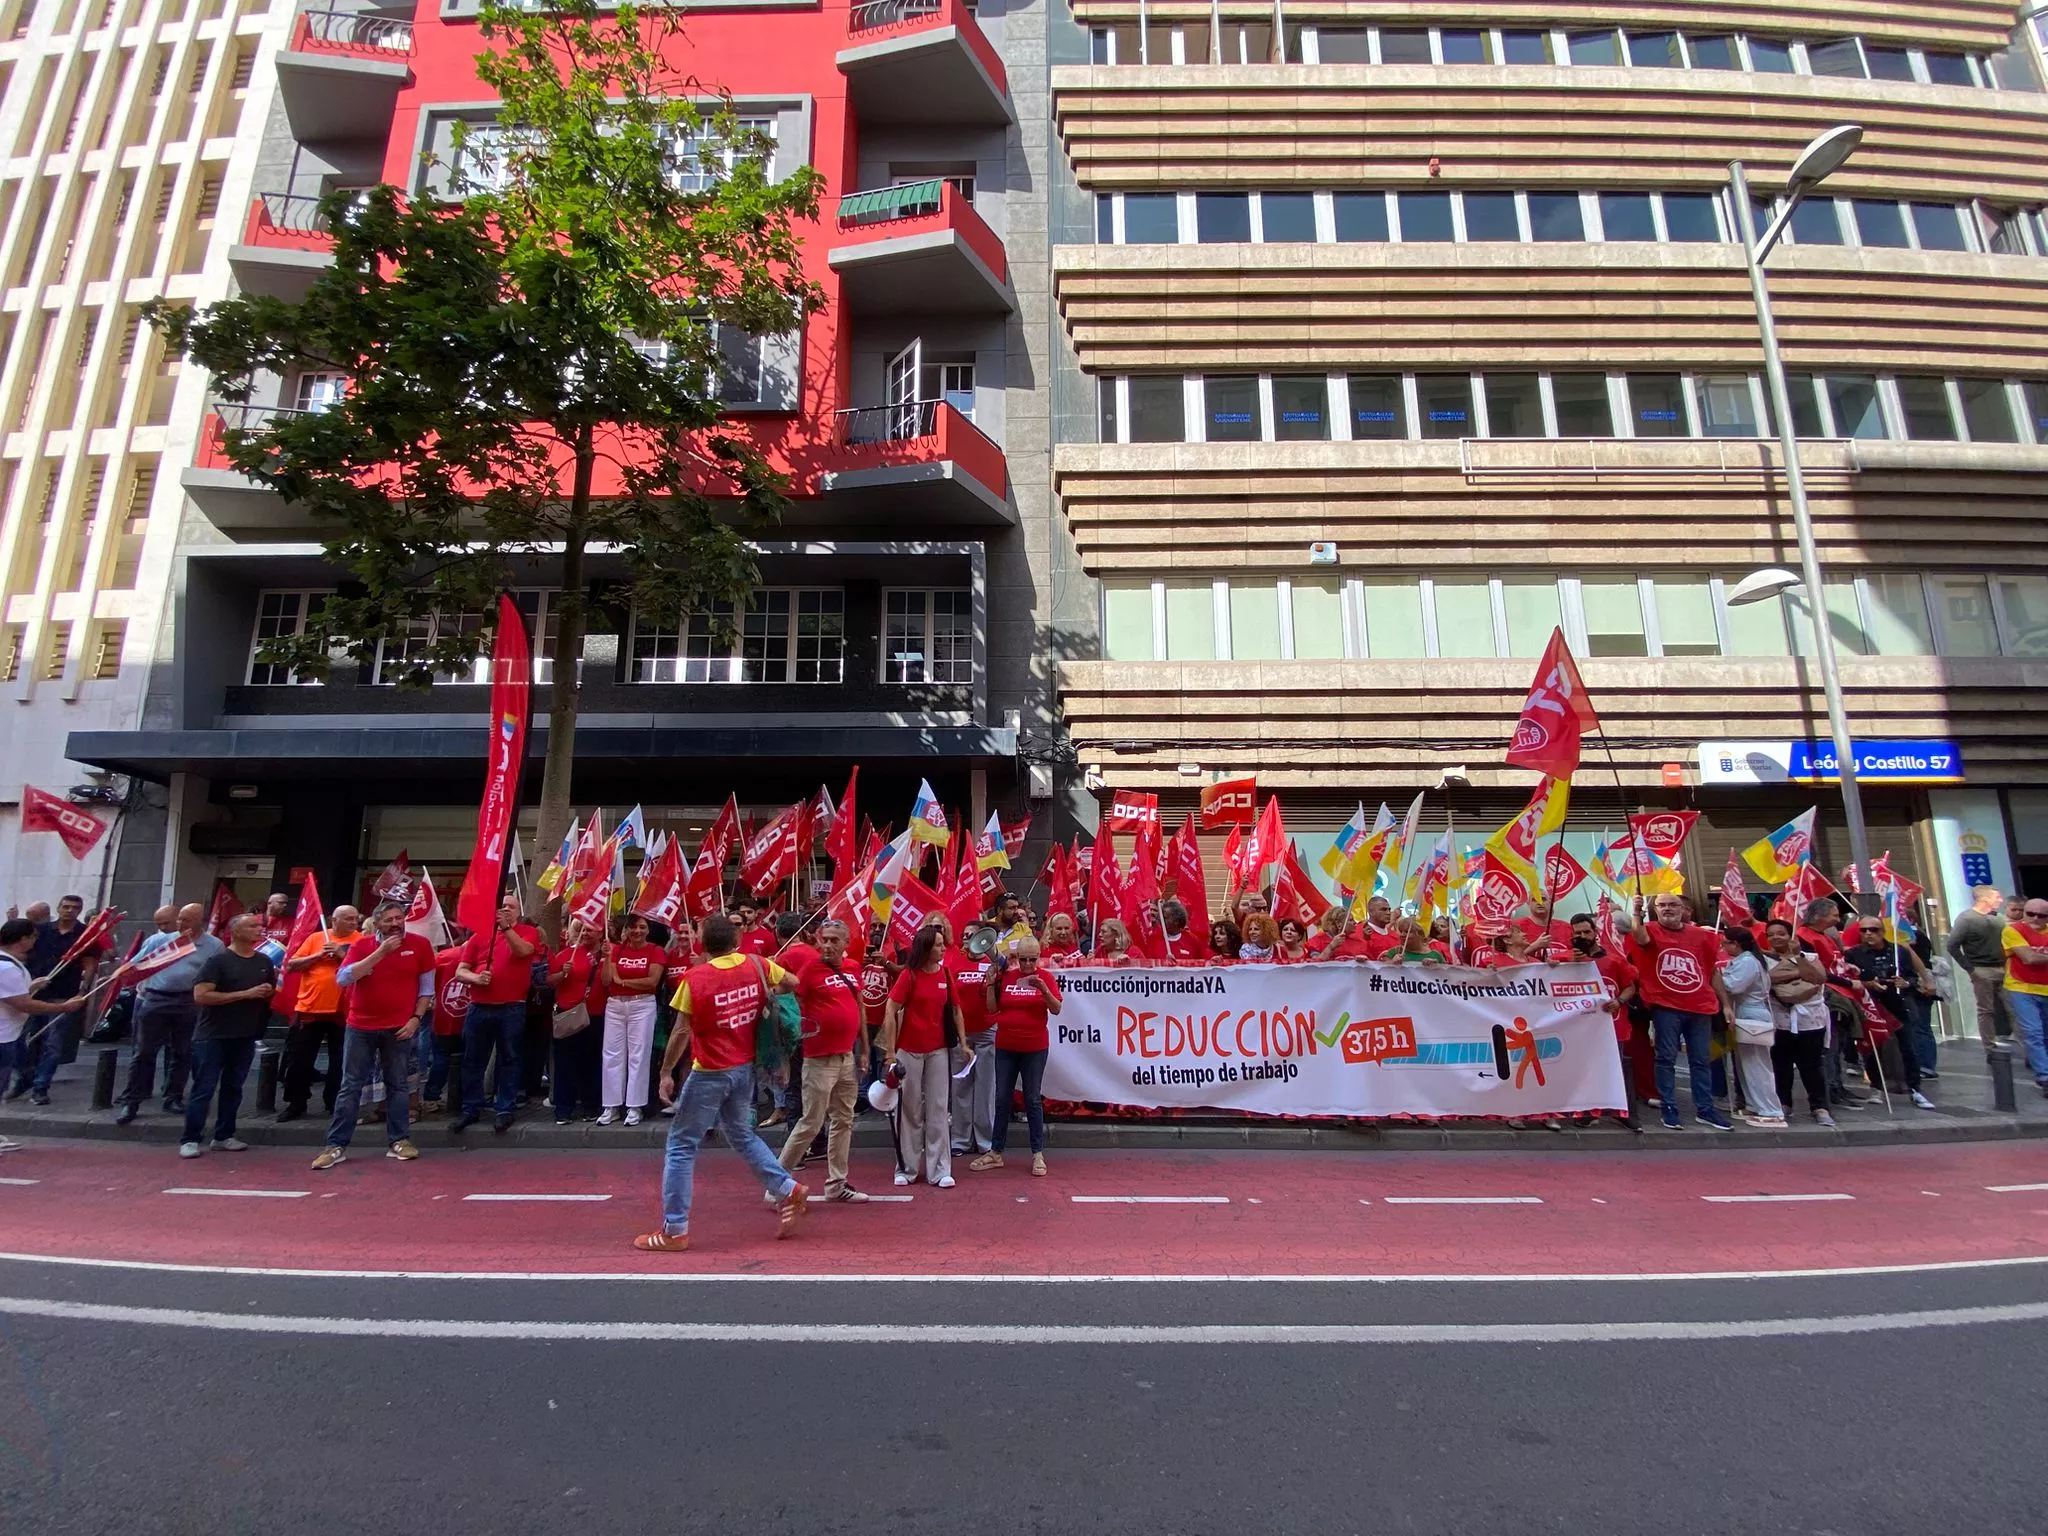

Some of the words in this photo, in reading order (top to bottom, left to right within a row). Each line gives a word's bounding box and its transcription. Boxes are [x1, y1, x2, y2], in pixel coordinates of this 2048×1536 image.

[1864, 755, 1926, 770] Castillo
[1930, 755, 1950, 769] 57
[618, 957, 647, 966] CCOO
[1662, 954, 1696, 976] UGT
[862, 970, 888, 988] UGT
[1056, 974, 1226, 998] #reducciónjornadaYA
[1369, 974, 1548, 1001] #reducciónjornadaYA
[1553, 985, 1584, 995] CCOO
[714, 983, 759, 1006] CCOO
[1553, 1001, 1580, 1012] UGT
[1058, 1024, 1084, 1043] Por
[1087, 1024, 1101, 1043] la
[1116, 1005, 1318, 1058] REDUCCIÓN
[1132, 1066, 1155, 1085] del
[1160, 1065, 1214, 1088] tiempo
[1219, 1062, 1238, 1082] de
[1240, 1060, 1298, 1083] trabajo
